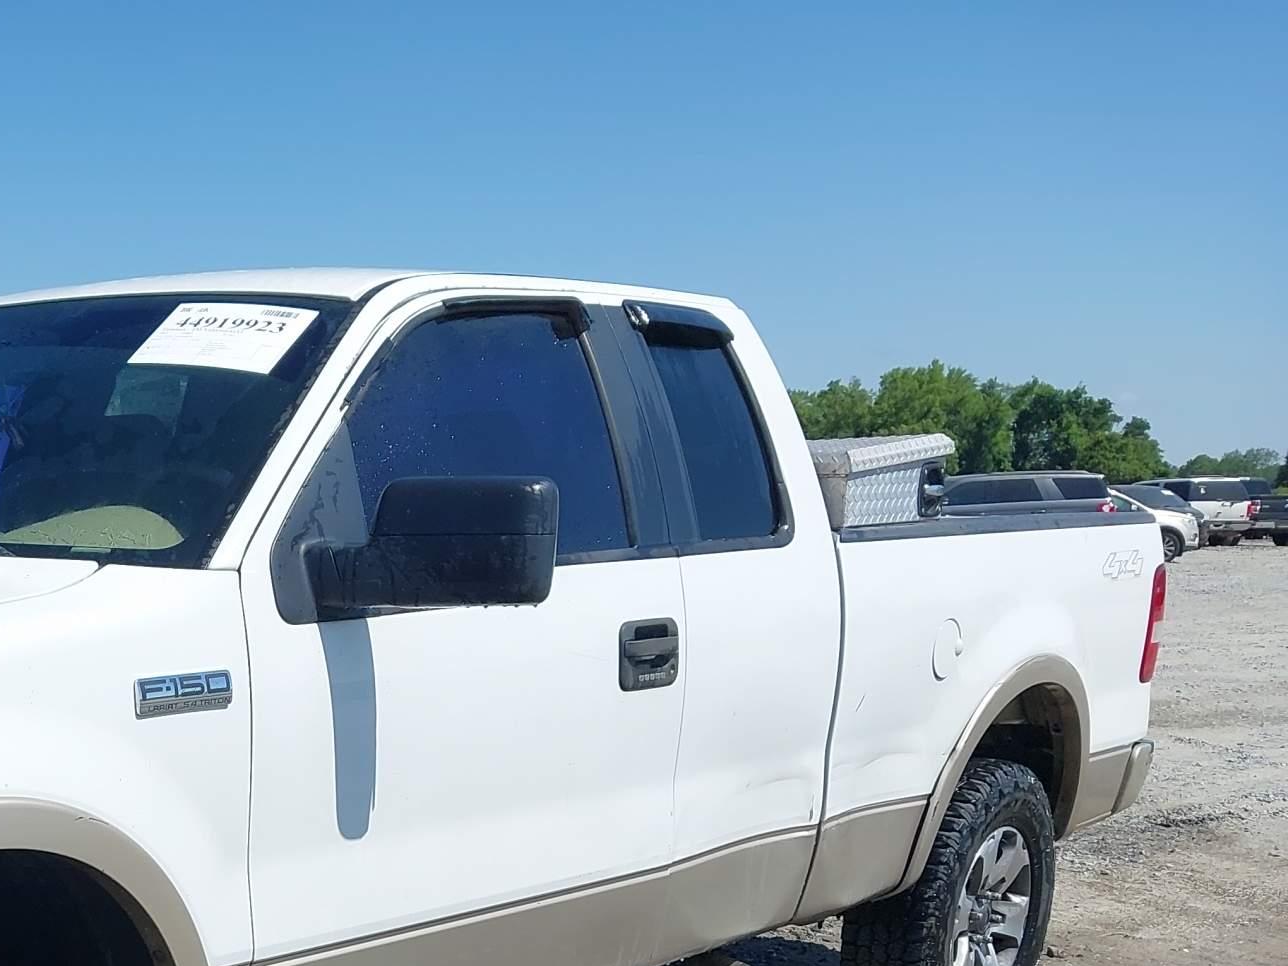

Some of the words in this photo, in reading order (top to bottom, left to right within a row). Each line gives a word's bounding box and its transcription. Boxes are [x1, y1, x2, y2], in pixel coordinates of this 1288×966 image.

[176, 316, 288, 334] 44919923
[1102, 549, 1144, 579] 4x4
[138, 672, 231, 701] F-150
[148, 702, 179, 712] LARIAT
[199, 696, 232, 706] TRITON
